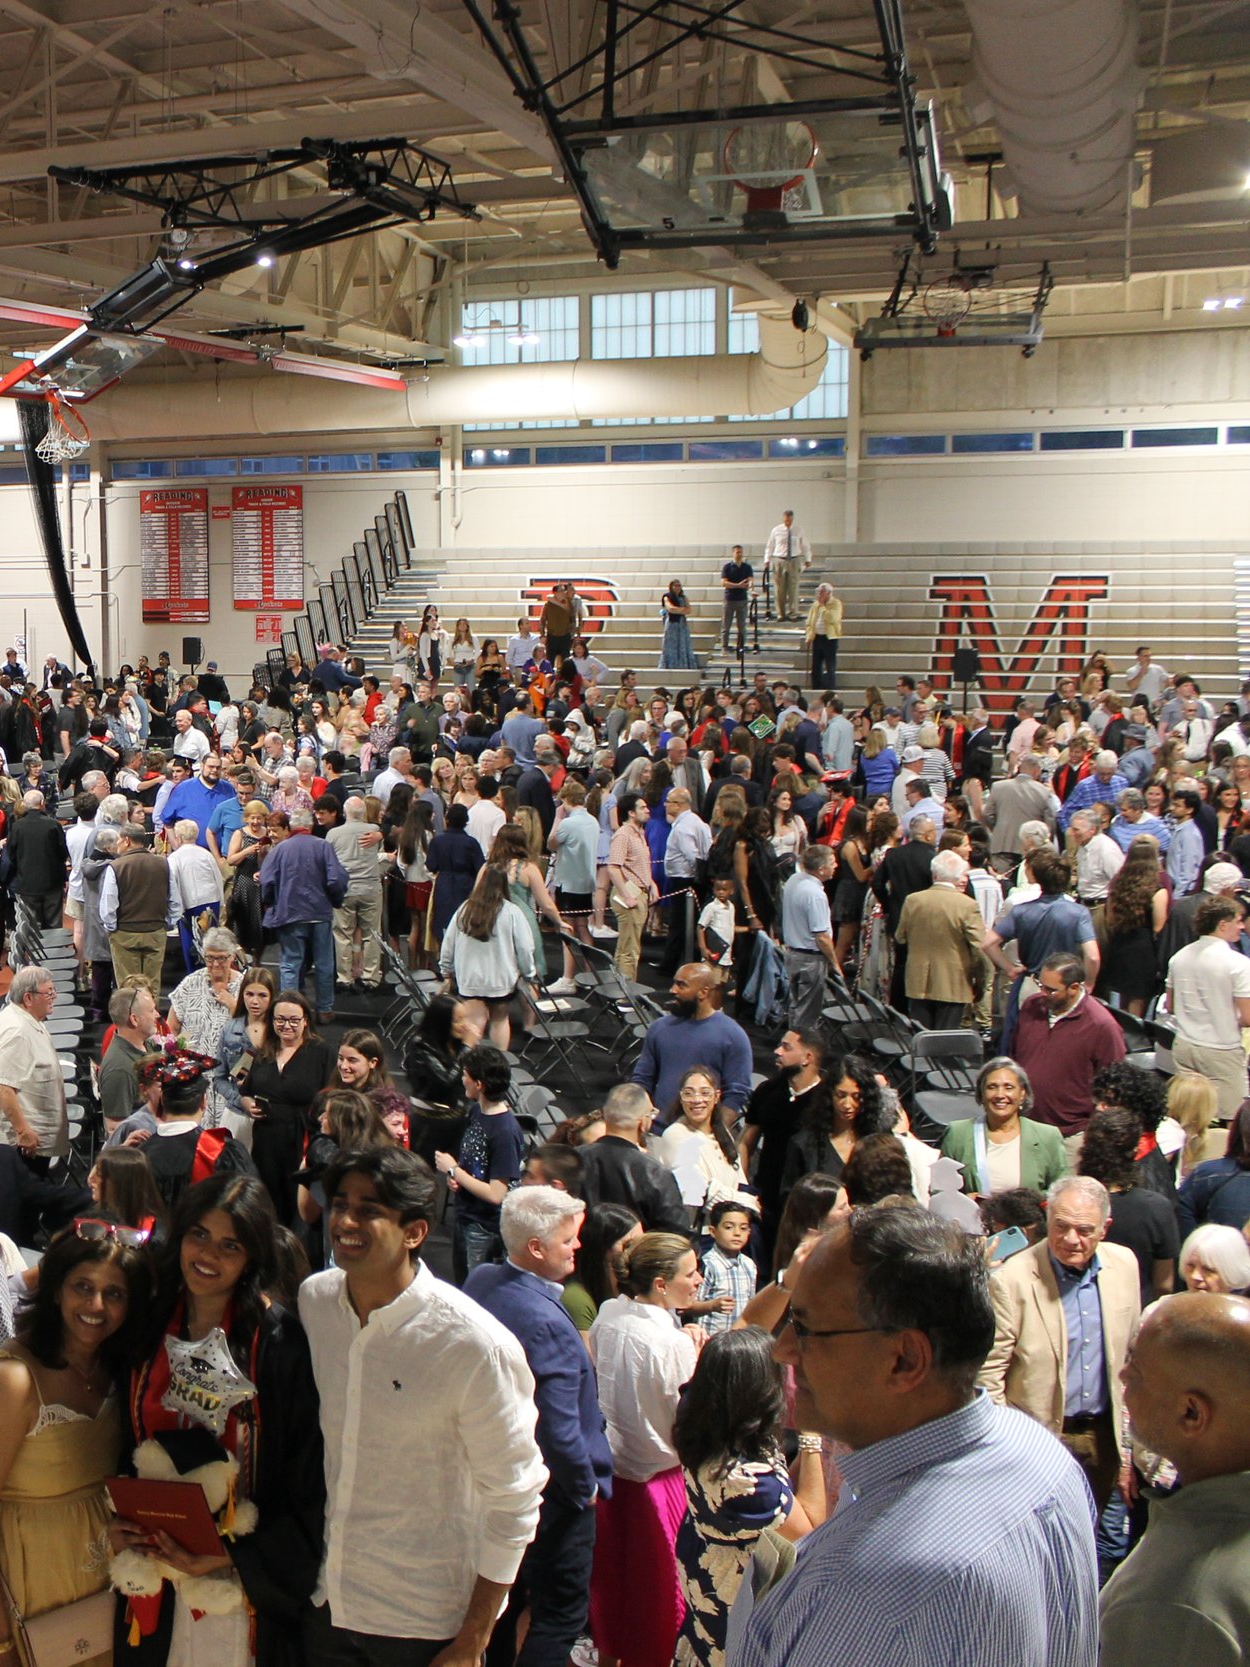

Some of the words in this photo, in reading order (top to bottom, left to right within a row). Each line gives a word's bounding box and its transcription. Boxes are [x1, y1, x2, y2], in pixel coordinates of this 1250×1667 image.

[154, 492, 193, 502] READING
[246, 488, 288, 499] READING
[922, 574, 1112, 738] M
[175, 1362, 219, 1392] Congrats
